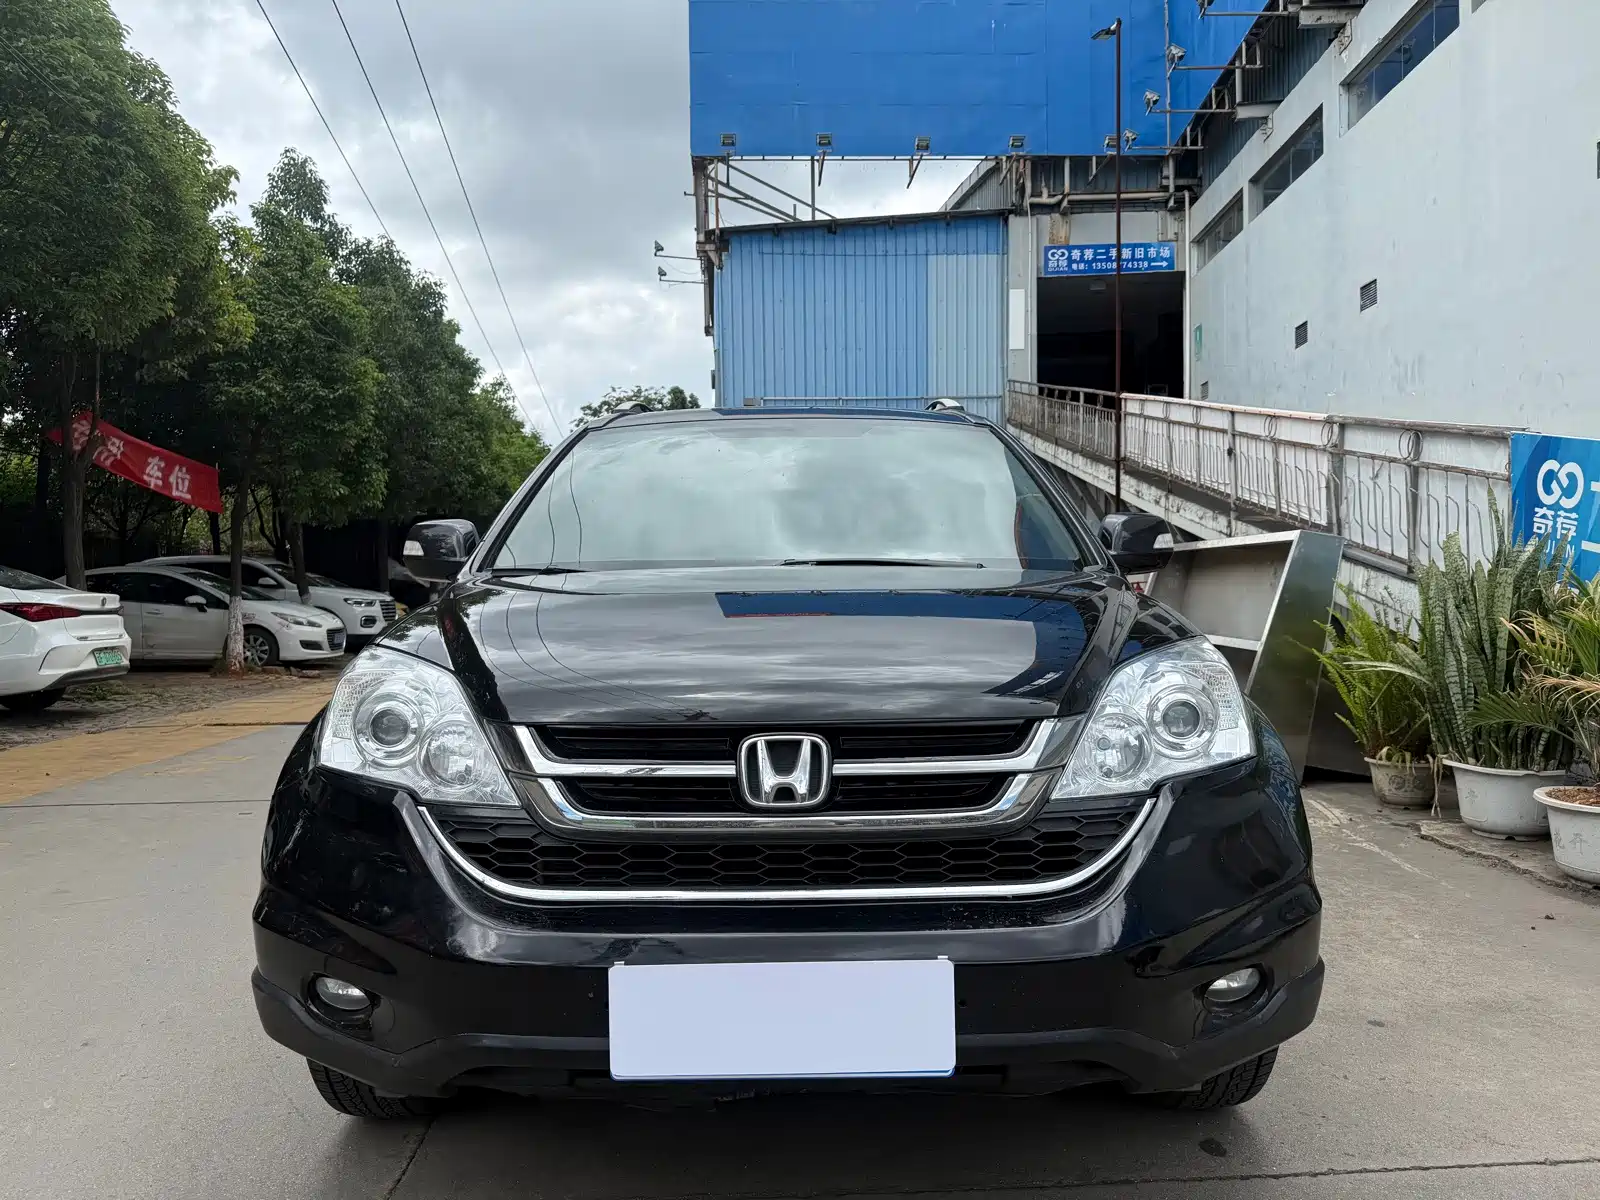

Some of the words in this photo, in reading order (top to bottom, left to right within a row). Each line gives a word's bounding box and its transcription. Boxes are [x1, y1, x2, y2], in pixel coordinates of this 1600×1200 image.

[1070, 247, 1170, 261] 奇荐二手新旧市场
[1092, 261, 1148, 270] 1350874338
[1533, 506, 1579, 541] 奇荐
